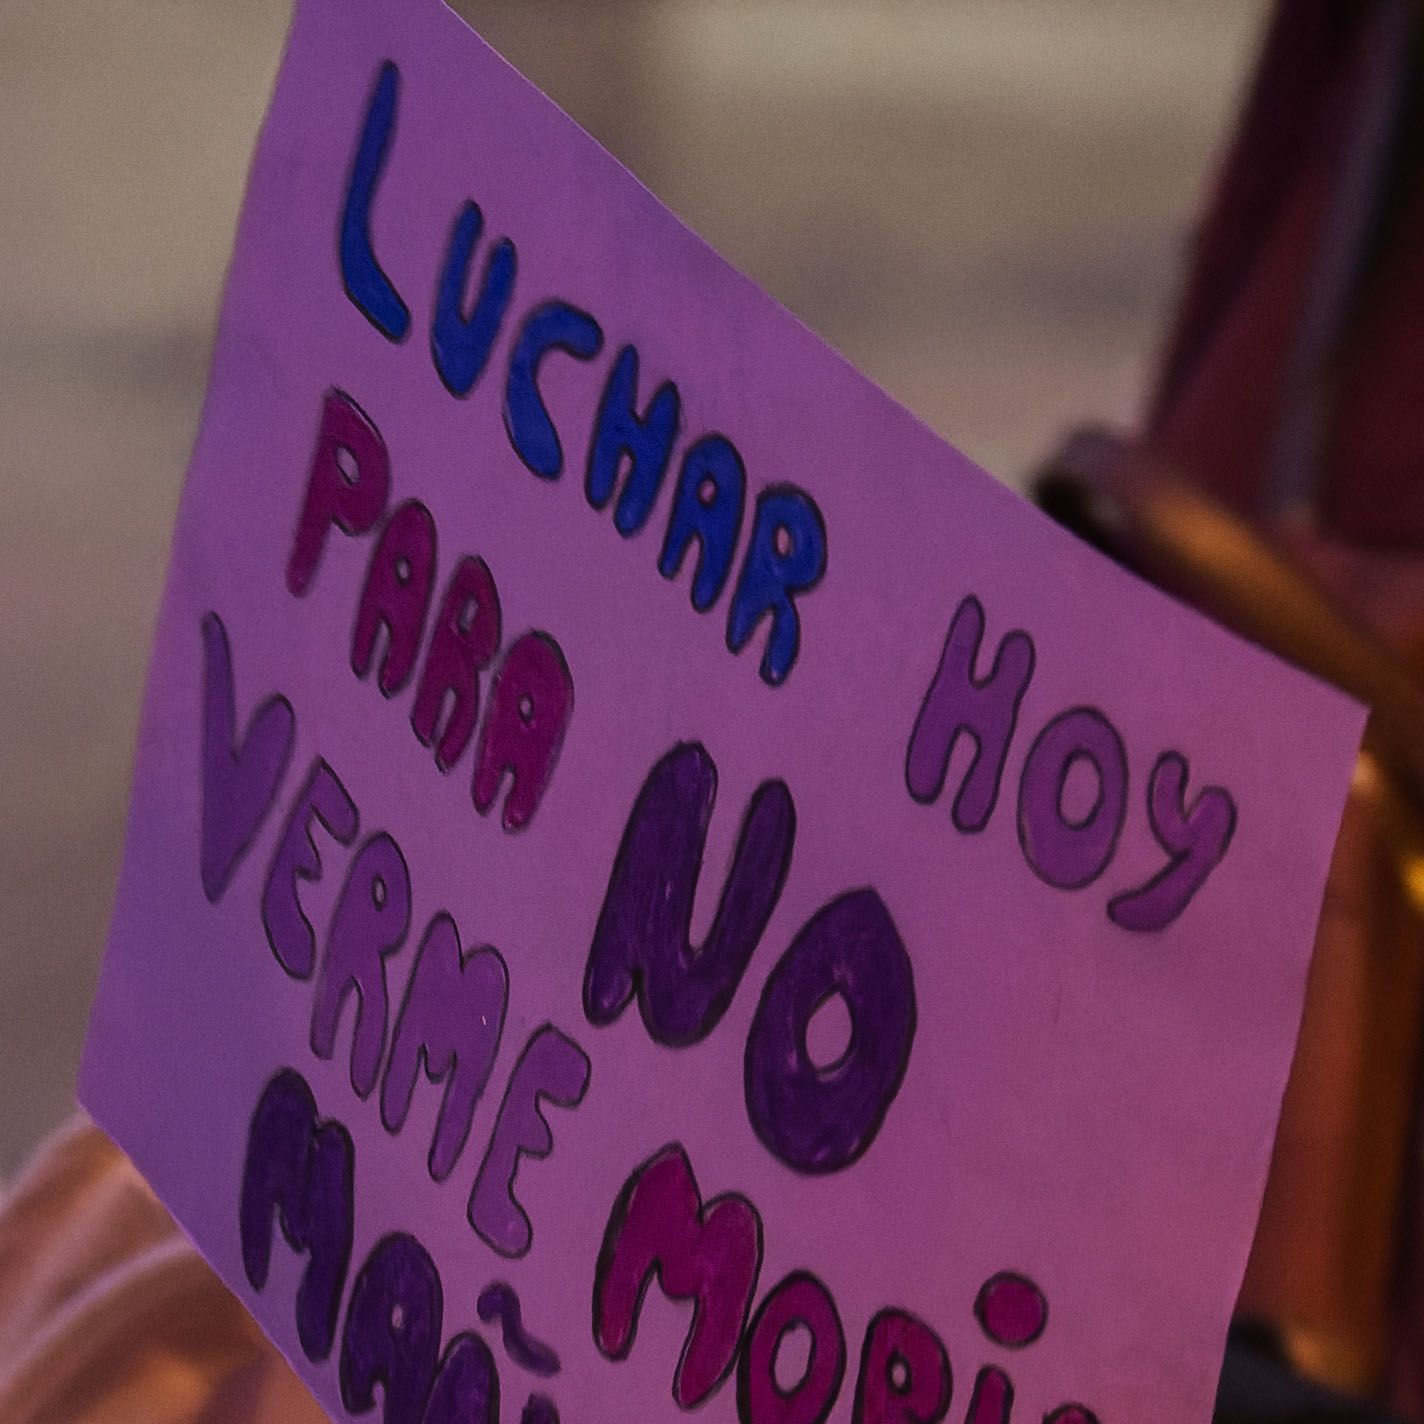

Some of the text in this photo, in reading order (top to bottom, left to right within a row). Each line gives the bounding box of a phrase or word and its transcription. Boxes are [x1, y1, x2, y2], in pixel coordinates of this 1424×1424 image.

[285, 387, 917, 1174] PARA NO
[337, 60, 1238, 933] LUCHAR HOY
[200, 610, 592, 1258] VERME
